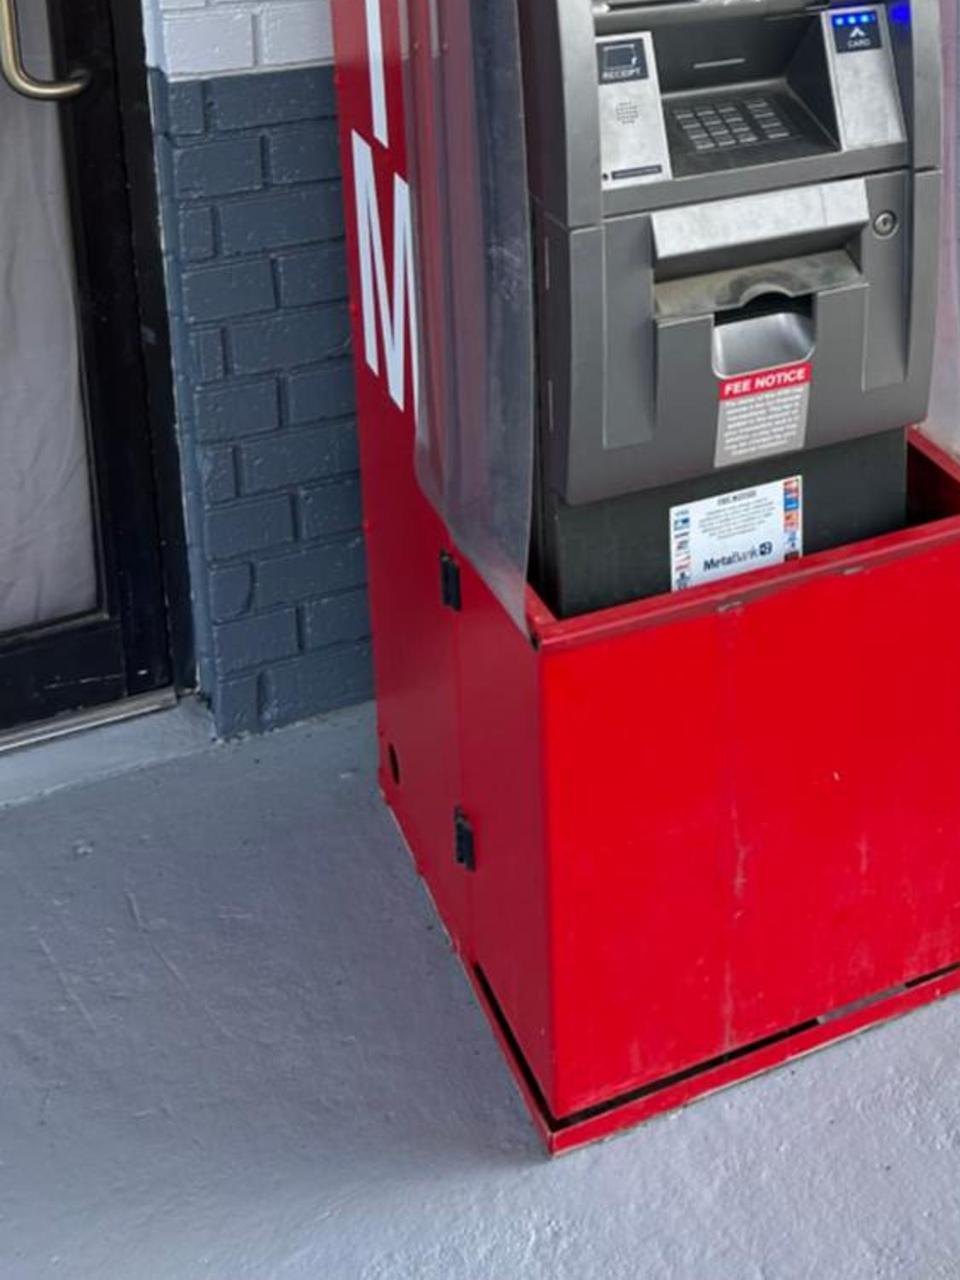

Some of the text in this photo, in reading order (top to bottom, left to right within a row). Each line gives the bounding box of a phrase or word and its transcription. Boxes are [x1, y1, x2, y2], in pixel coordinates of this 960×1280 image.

[847, 37, 871, 48] CARD
[602, 66, 643, 80] RECEIPT
[724, 367, 806, 396] FEE NOTICE
